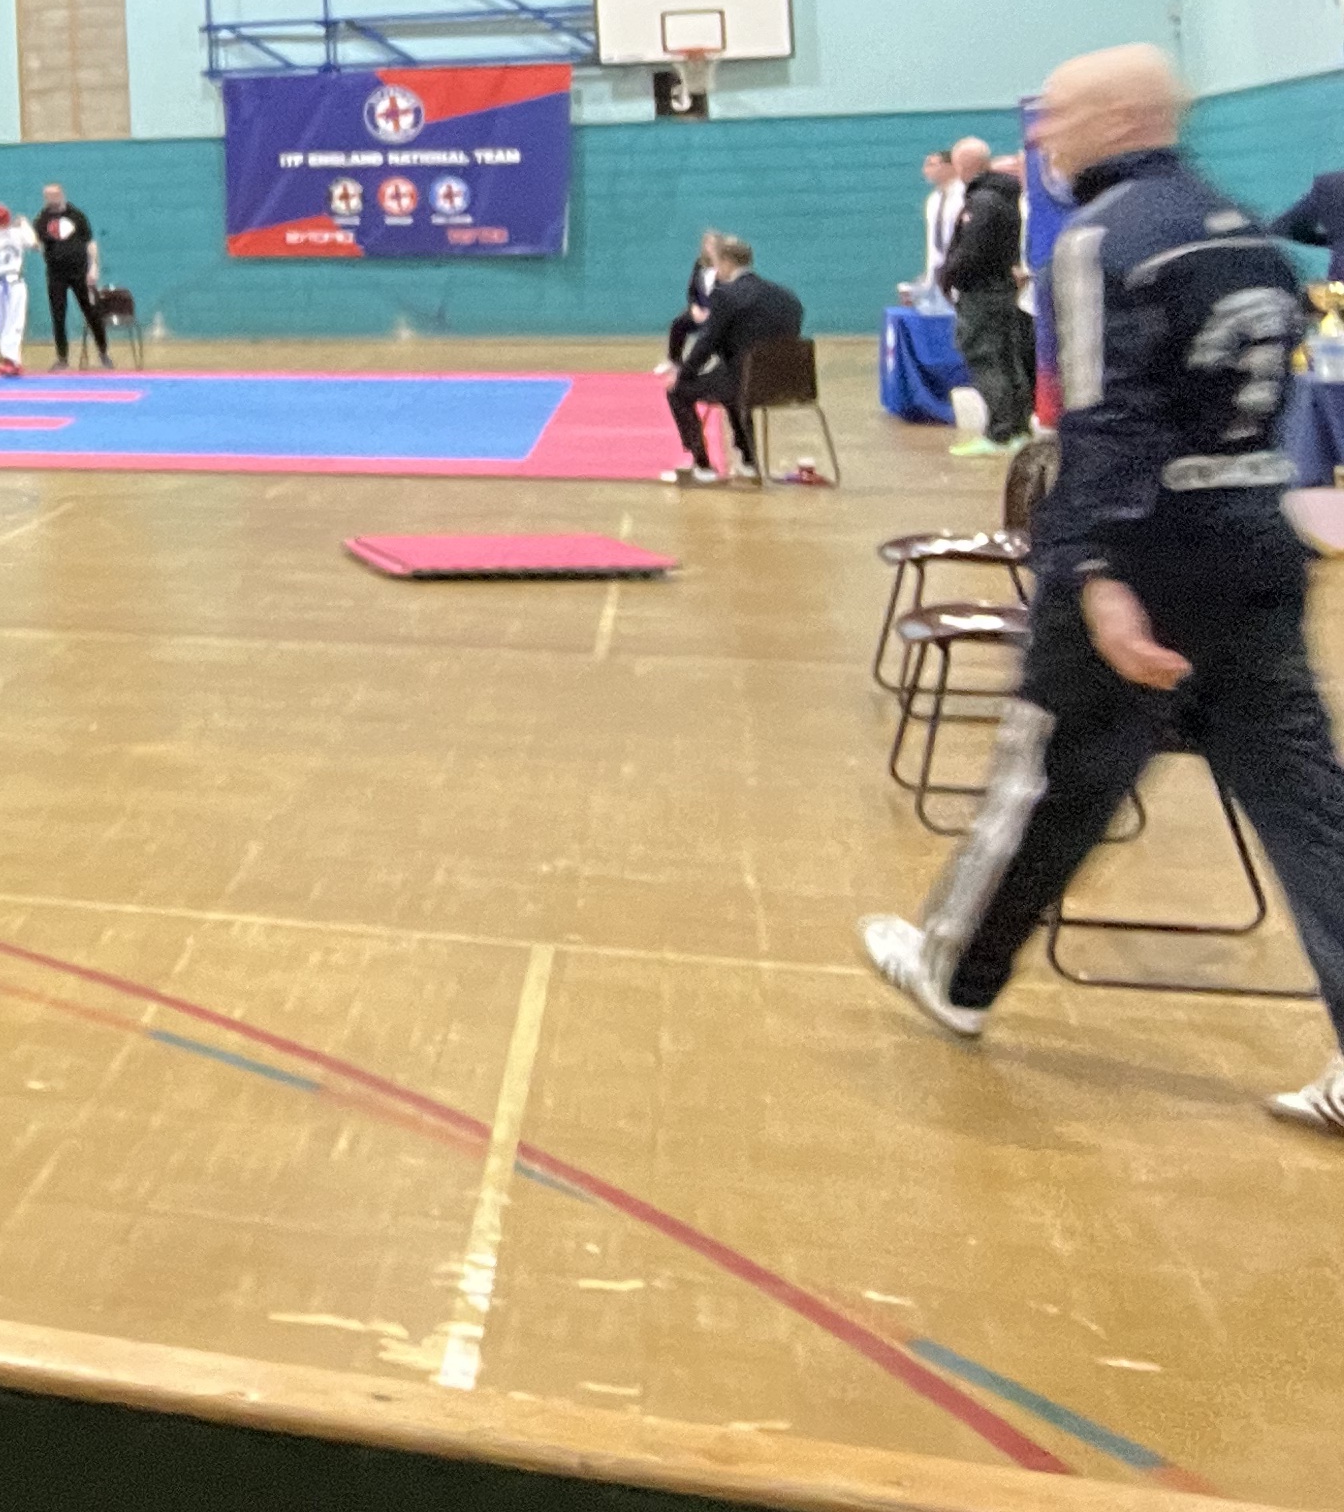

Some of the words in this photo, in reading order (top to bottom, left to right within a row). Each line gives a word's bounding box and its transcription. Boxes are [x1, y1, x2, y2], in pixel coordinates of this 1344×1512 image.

[308, 151, 384, 167] ENGLAND
[388, 149, 469, 166] NATIONAL
[473, 147, 521, 164] TEAM
